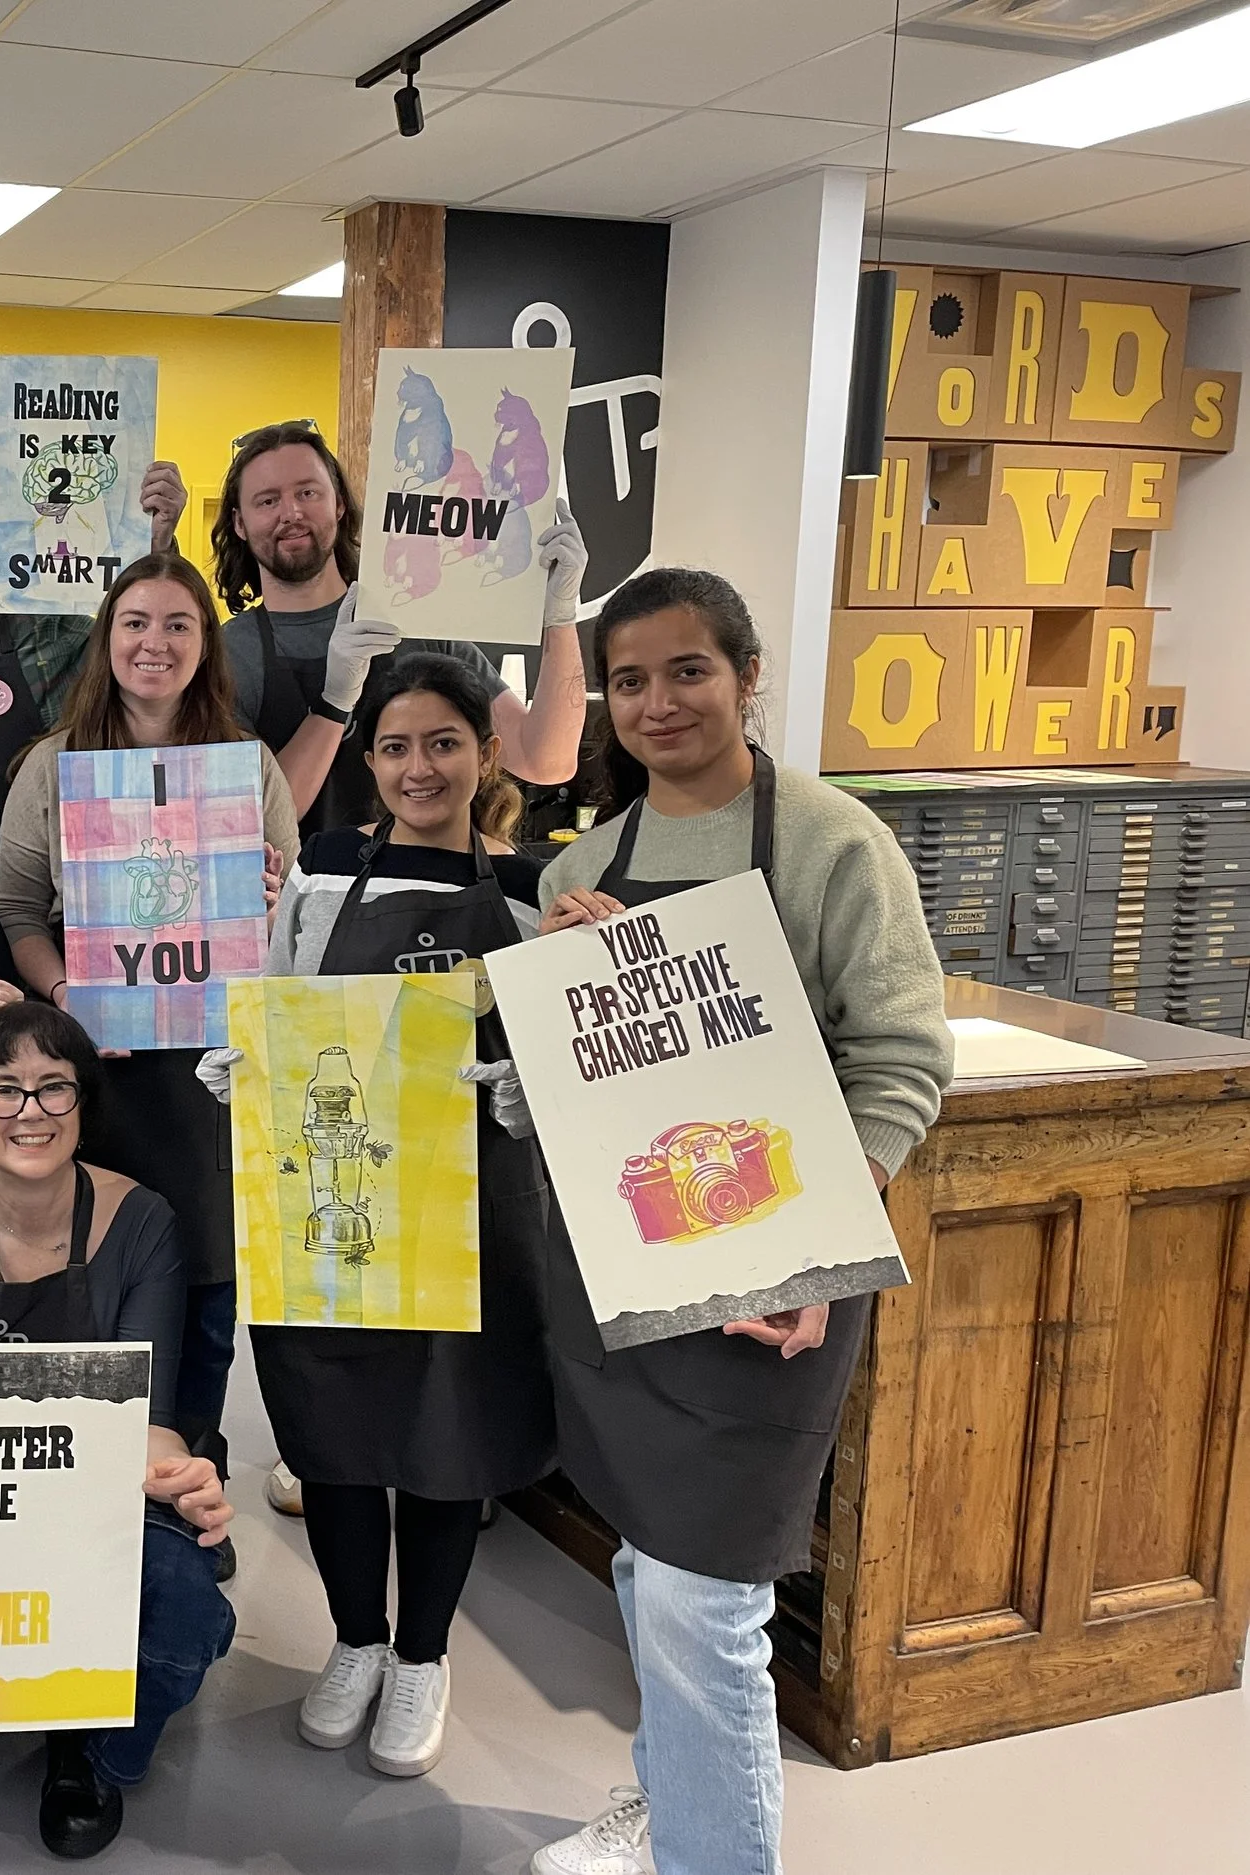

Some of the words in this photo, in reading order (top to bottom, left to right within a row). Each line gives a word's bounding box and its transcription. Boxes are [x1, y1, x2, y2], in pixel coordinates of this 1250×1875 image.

[14, 382, 120, 421] READING
[19, 433, 40, 459] IS
[61, 434, 117, 455] KEY
[48, 468, 72, 504] 2
[382, 491, 510, 541] MEOW
[8, 553, 122, 592] SMART
[153, 764, 166, 806] I
[598, 913, 669, 969] YOUR
[114, 940, 210, 987] YOU
[572, 1010, 691, 1082] CHANGED
